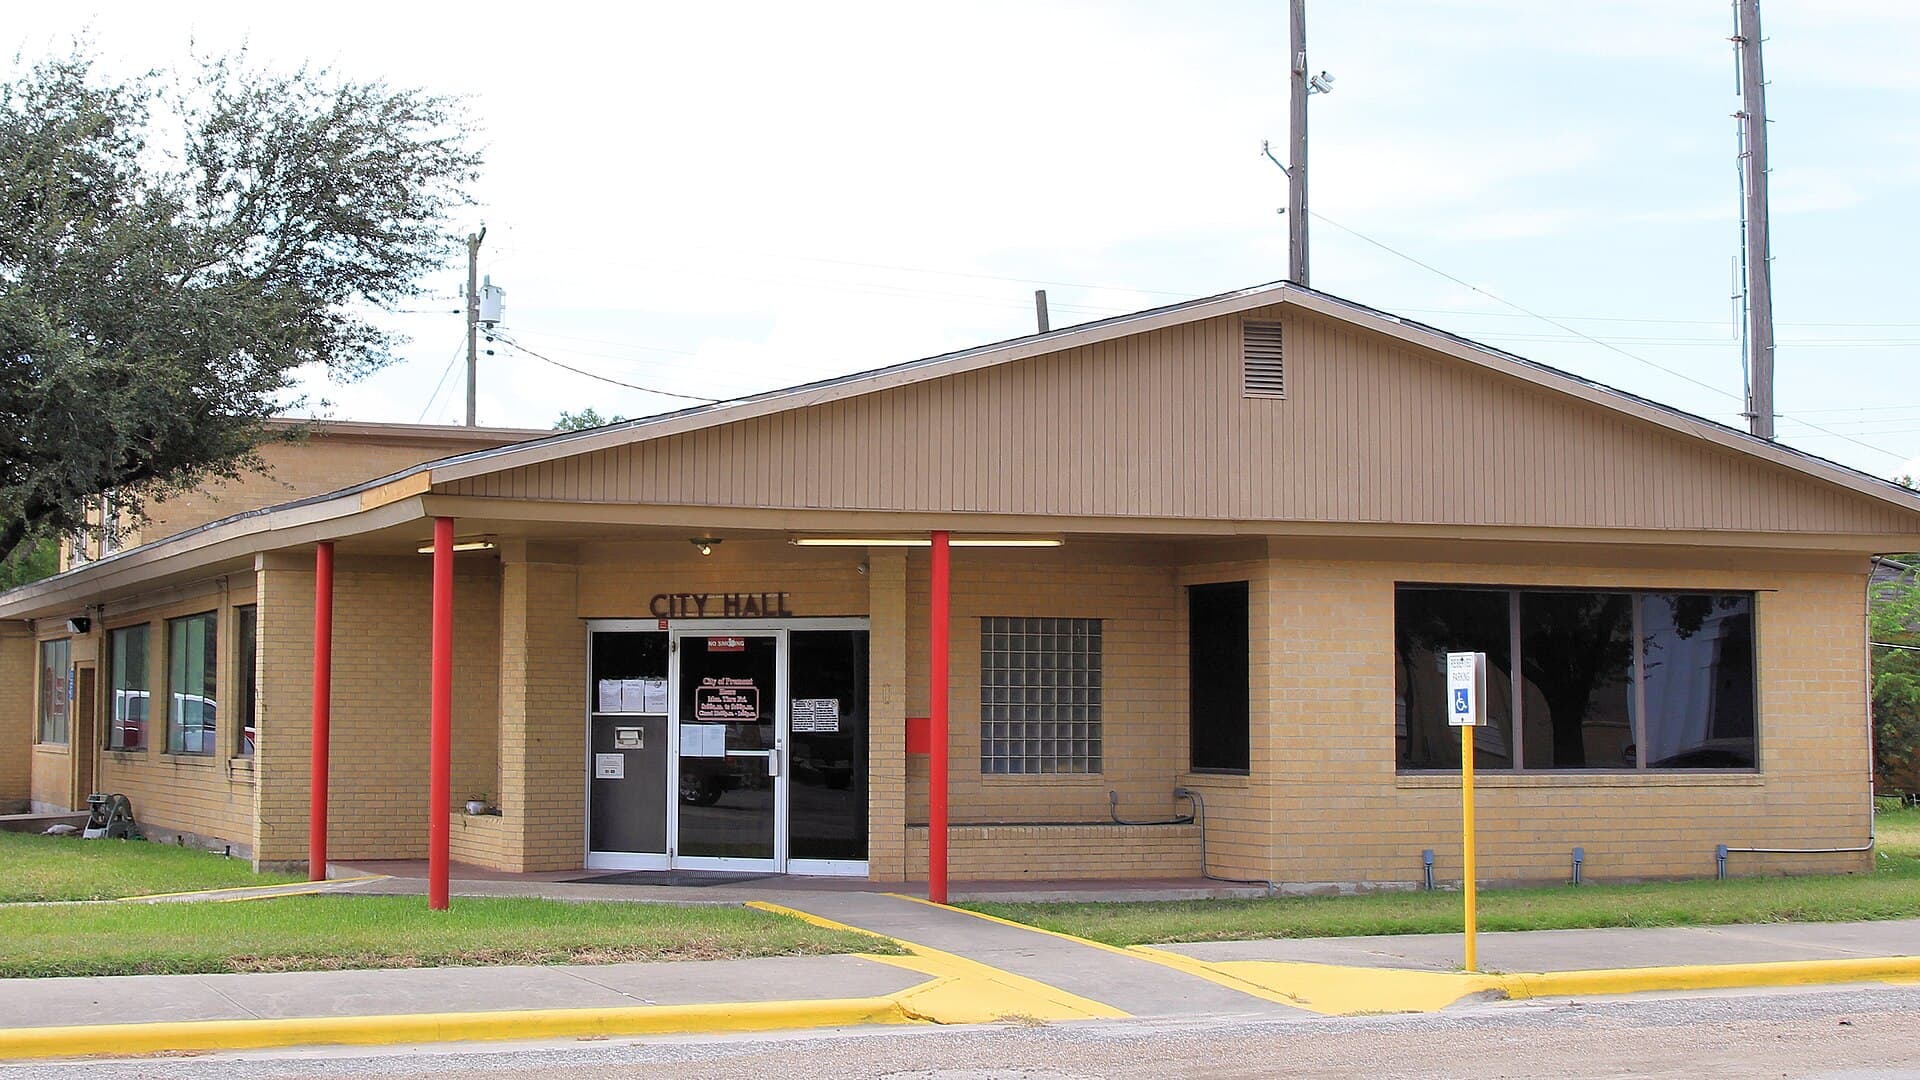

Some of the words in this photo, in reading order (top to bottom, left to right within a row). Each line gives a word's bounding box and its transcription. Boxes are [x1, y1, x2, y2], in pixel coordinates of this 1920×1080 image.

[649, 593, 708, 618] CITY
[724, 592, 792, 618] HALL
[702, 677, 717, 687] City
[717, 677, 725, 686] of
